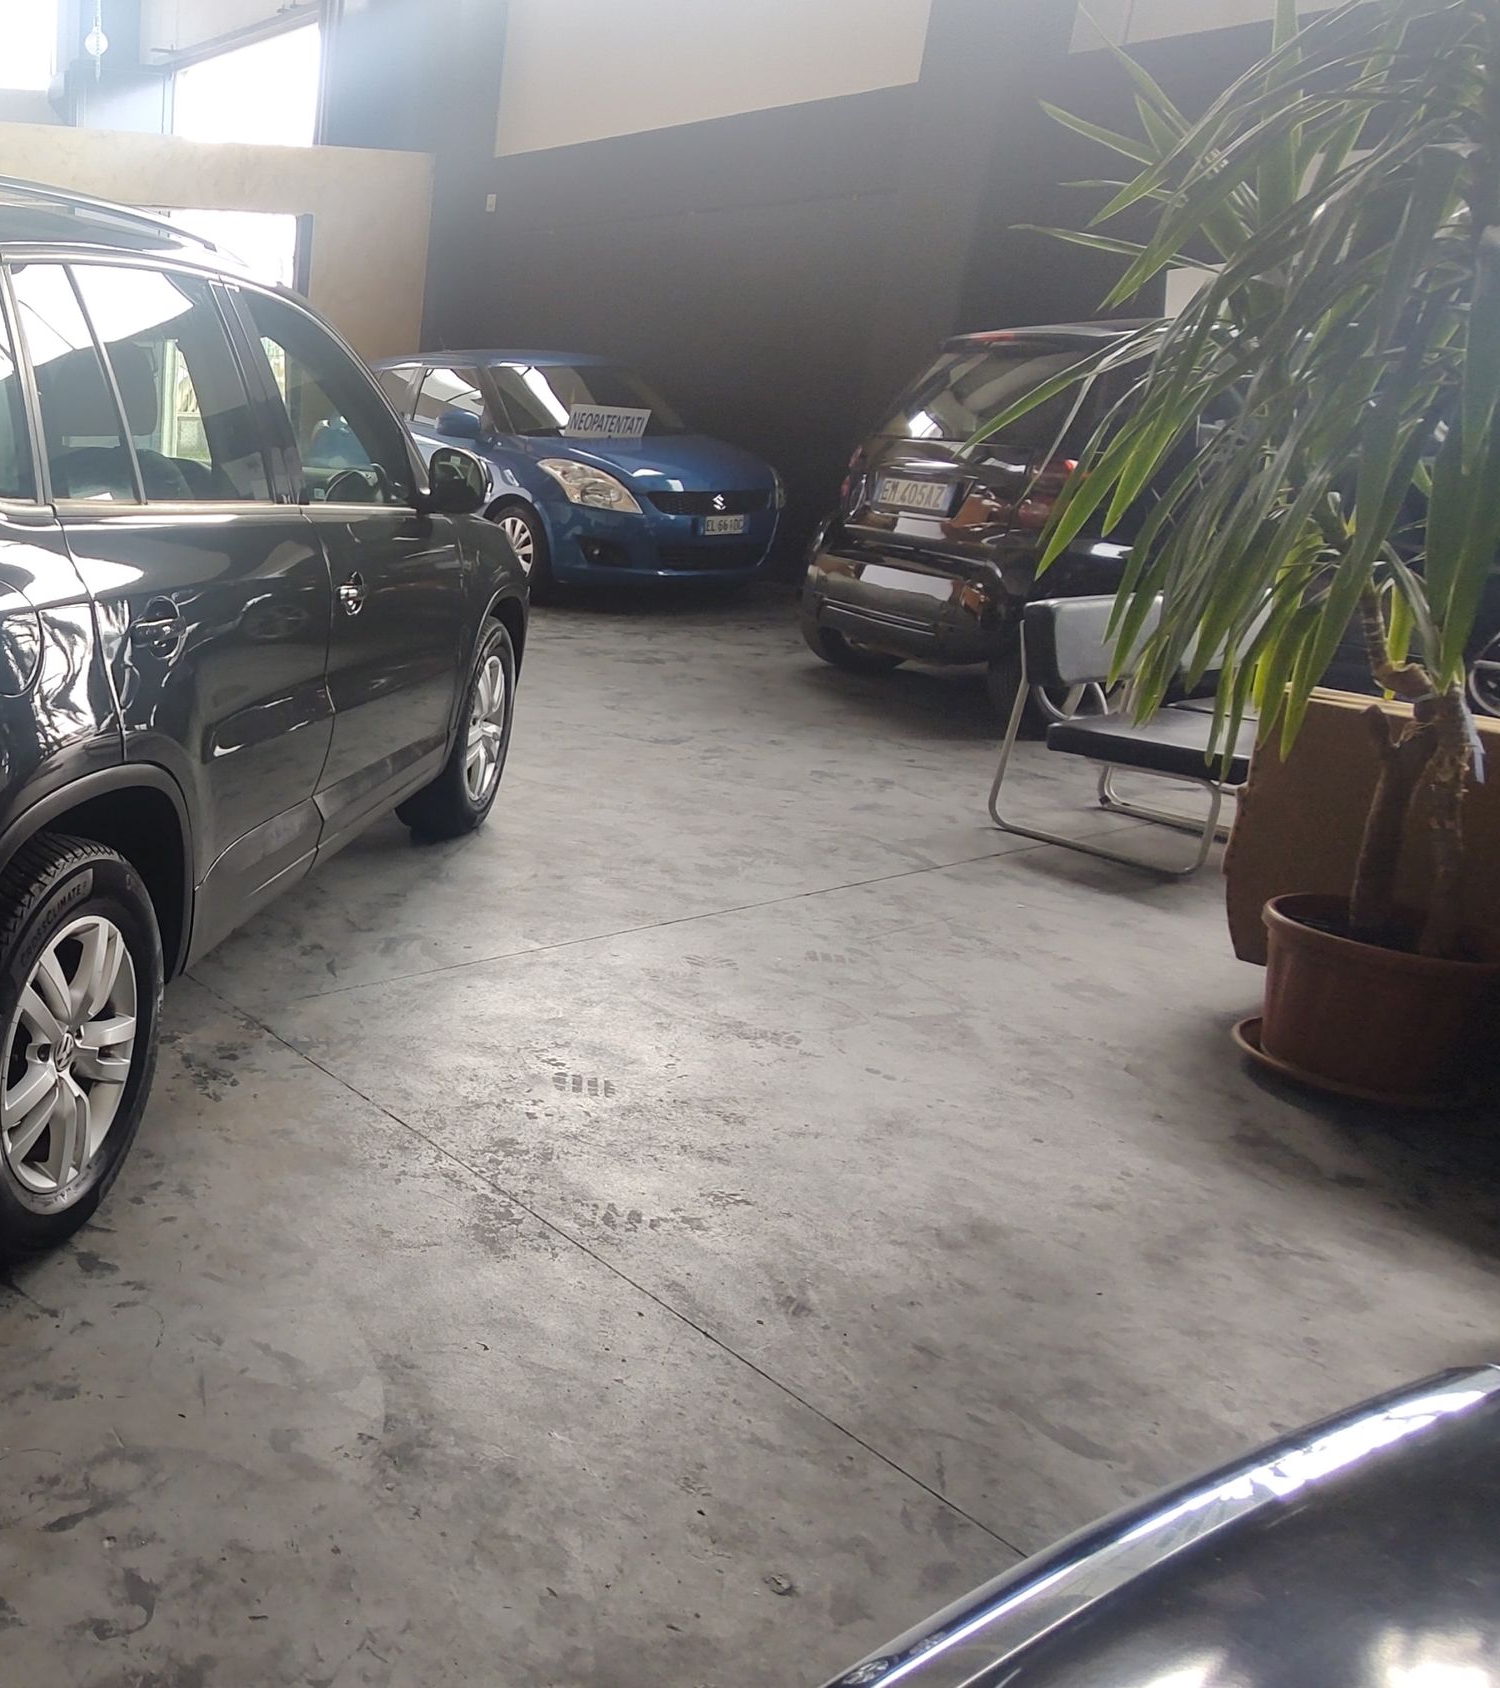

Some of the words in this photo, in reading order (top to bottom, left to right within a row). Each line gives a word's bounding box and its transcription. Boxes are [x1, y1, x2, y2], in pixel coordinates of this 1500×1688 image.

[570, 411, 646, 434] NEOPATENTATI
[881, 480, 899, 502] EM
[899, 482, 946, 508] 405AZ
